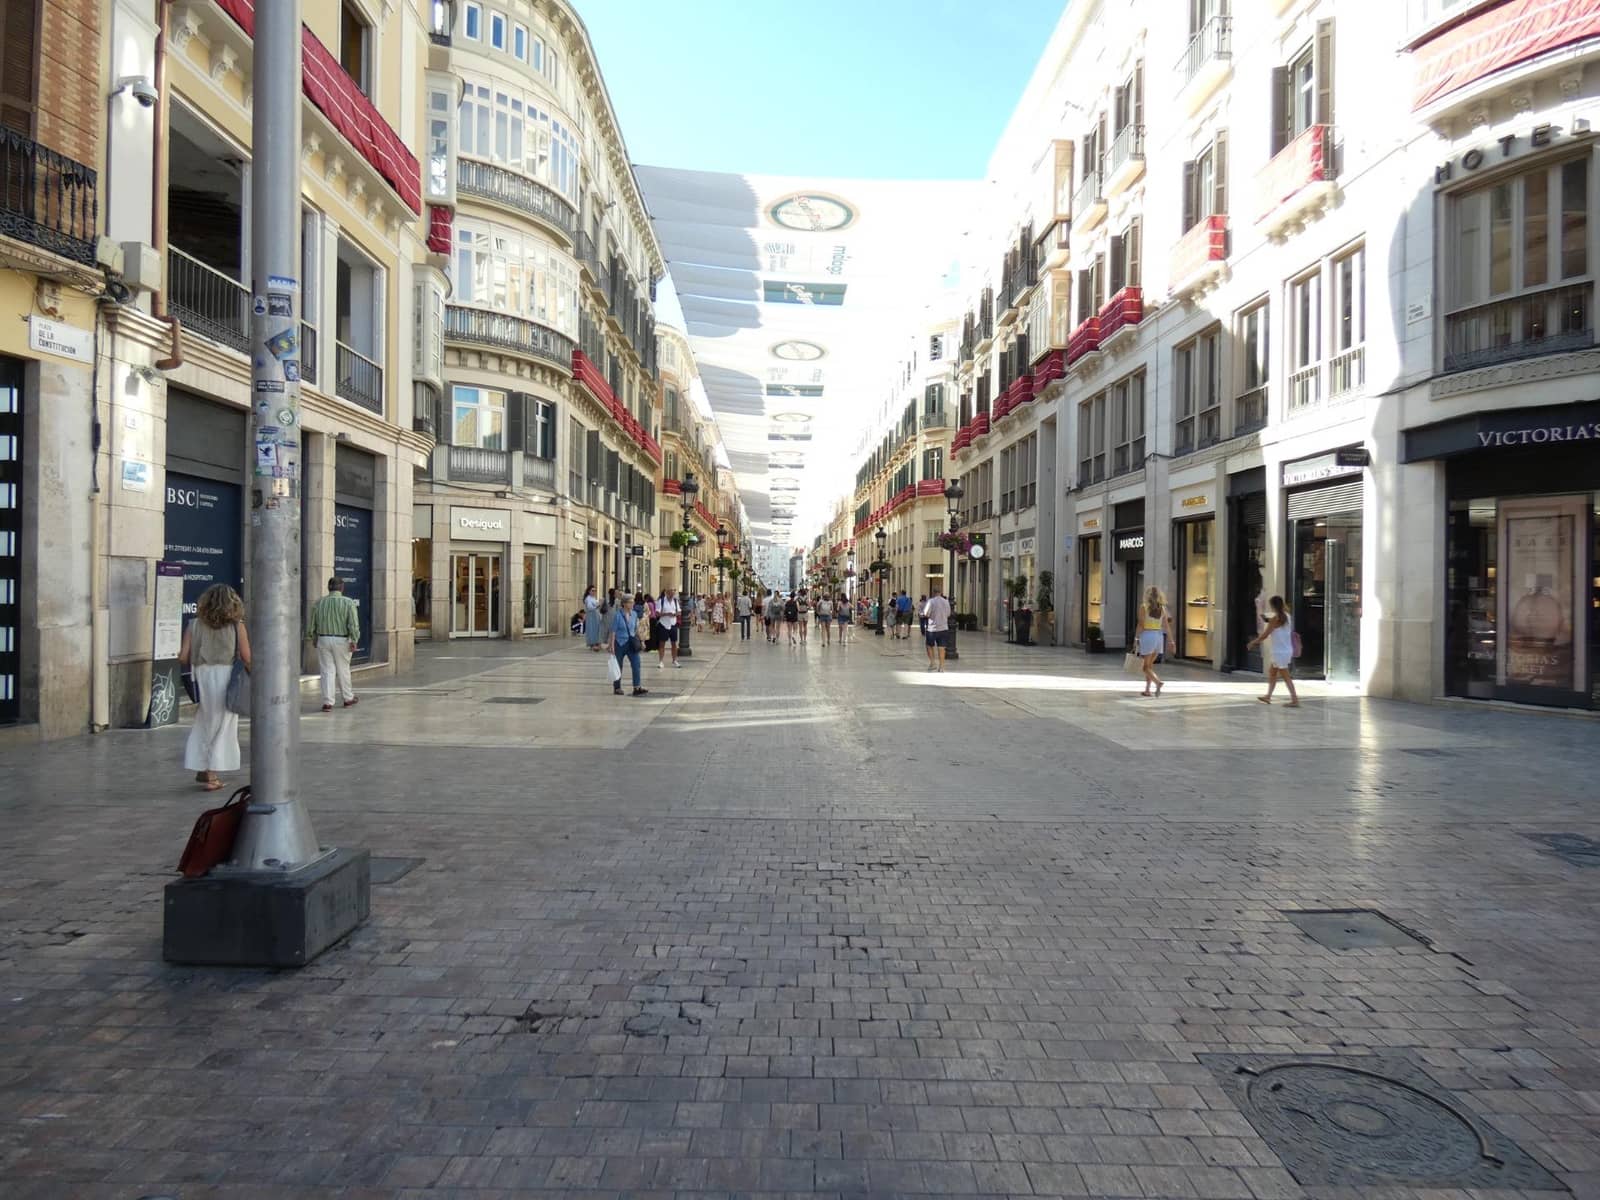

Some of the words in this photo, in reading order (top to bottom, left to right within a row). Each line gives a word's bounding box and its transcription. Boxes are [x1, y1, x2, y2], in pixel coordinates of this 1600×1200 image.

[1435, 112, 1592, 185] HOTEL
[167, 487, 196, 507] BSC
[460, 517, 503, 531] Desigual
[1119, 536, 1144, 549] MARCOS
[182, 602, 197, 615] ING
